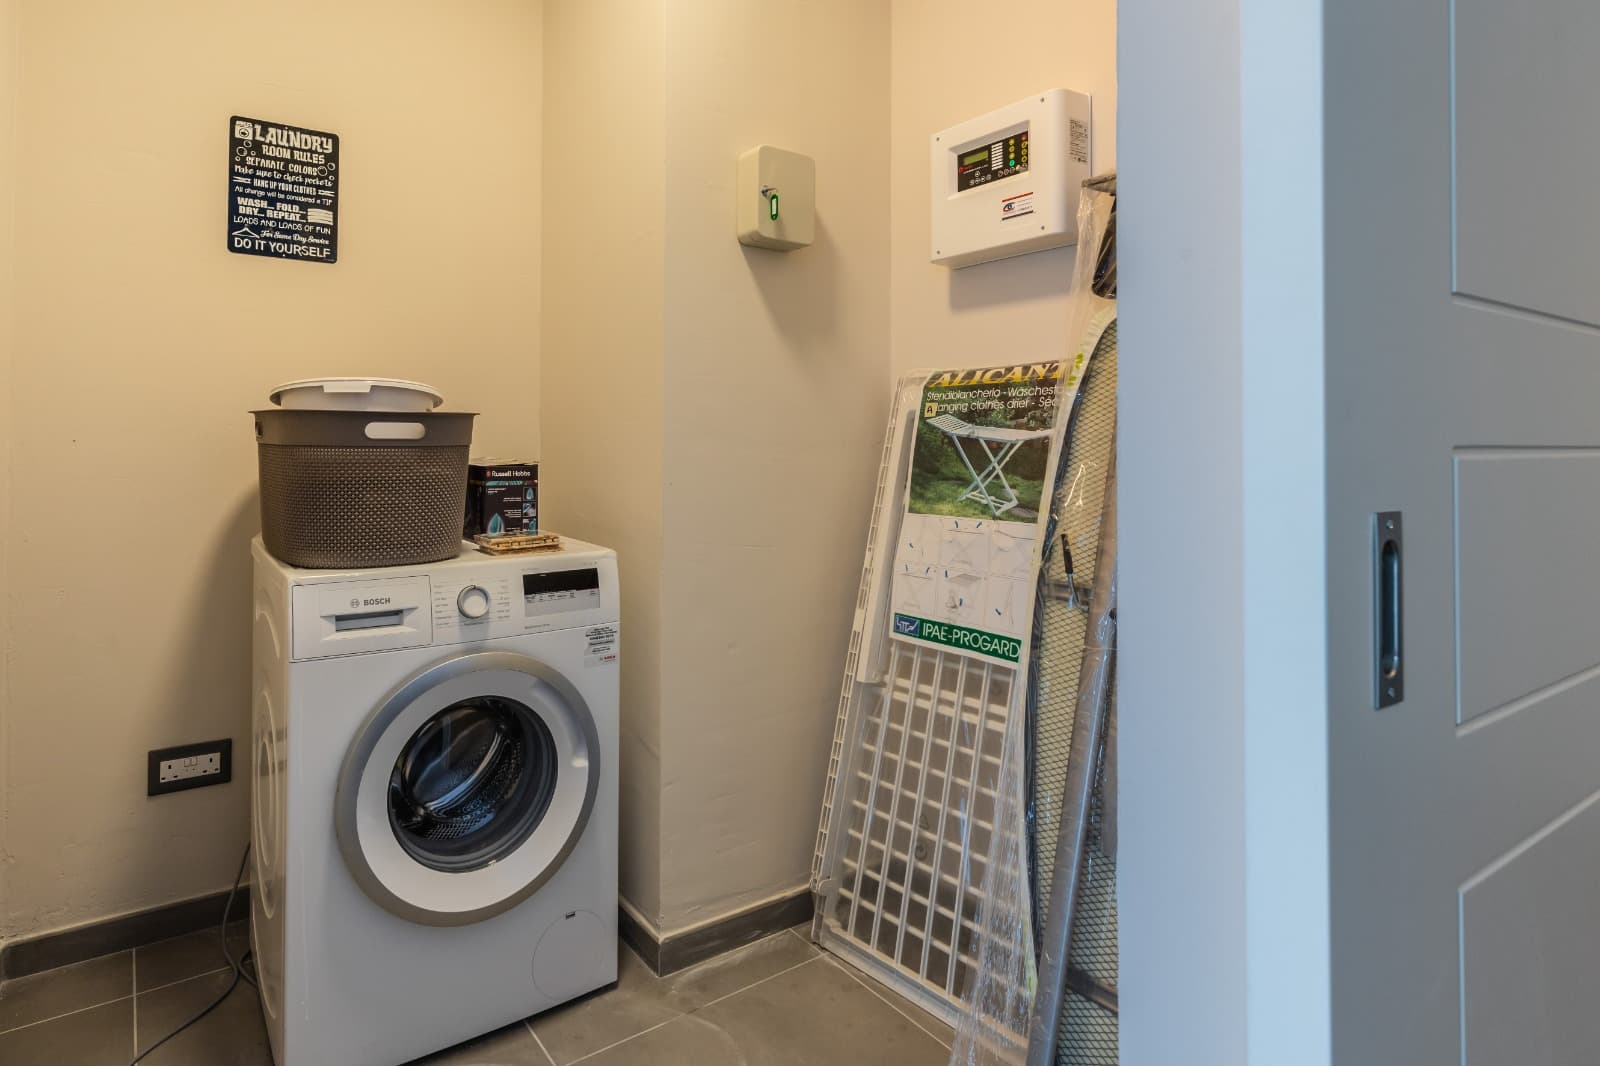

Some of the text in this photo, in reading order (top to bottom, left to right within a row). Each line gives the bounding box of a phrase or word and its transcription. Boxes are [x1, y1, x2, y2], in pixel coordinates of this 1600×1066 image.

[254, 124, 333, 154] LAUNDRY
[262, 145, 325, 164] ROOM RULES
[234, 164, 334, 187] Make sure to check pockets
[246, 156, 318, 176] SEPARATE COLORS
[245, 188, 266, 197] change
[287, 194, 315, 203] considered
[253, 178, 316, 195] HANG UP YOUR CLOTHES
[234, 216, 258, 224] LOADS
[260, 219, 277, 228] AND
[279, 222, 302, 230] LOADS
[316, 226, 331, 235] FUN
[234, 238, 331, 258] DO IT YOURSELF
[970, 398, 1004, 410] clothes
[1006, 398, 1030, 409] drier
[364, 597, 390, 606] BOSCH
[923, 623, 1020, 658] IPAE-PROGARD
